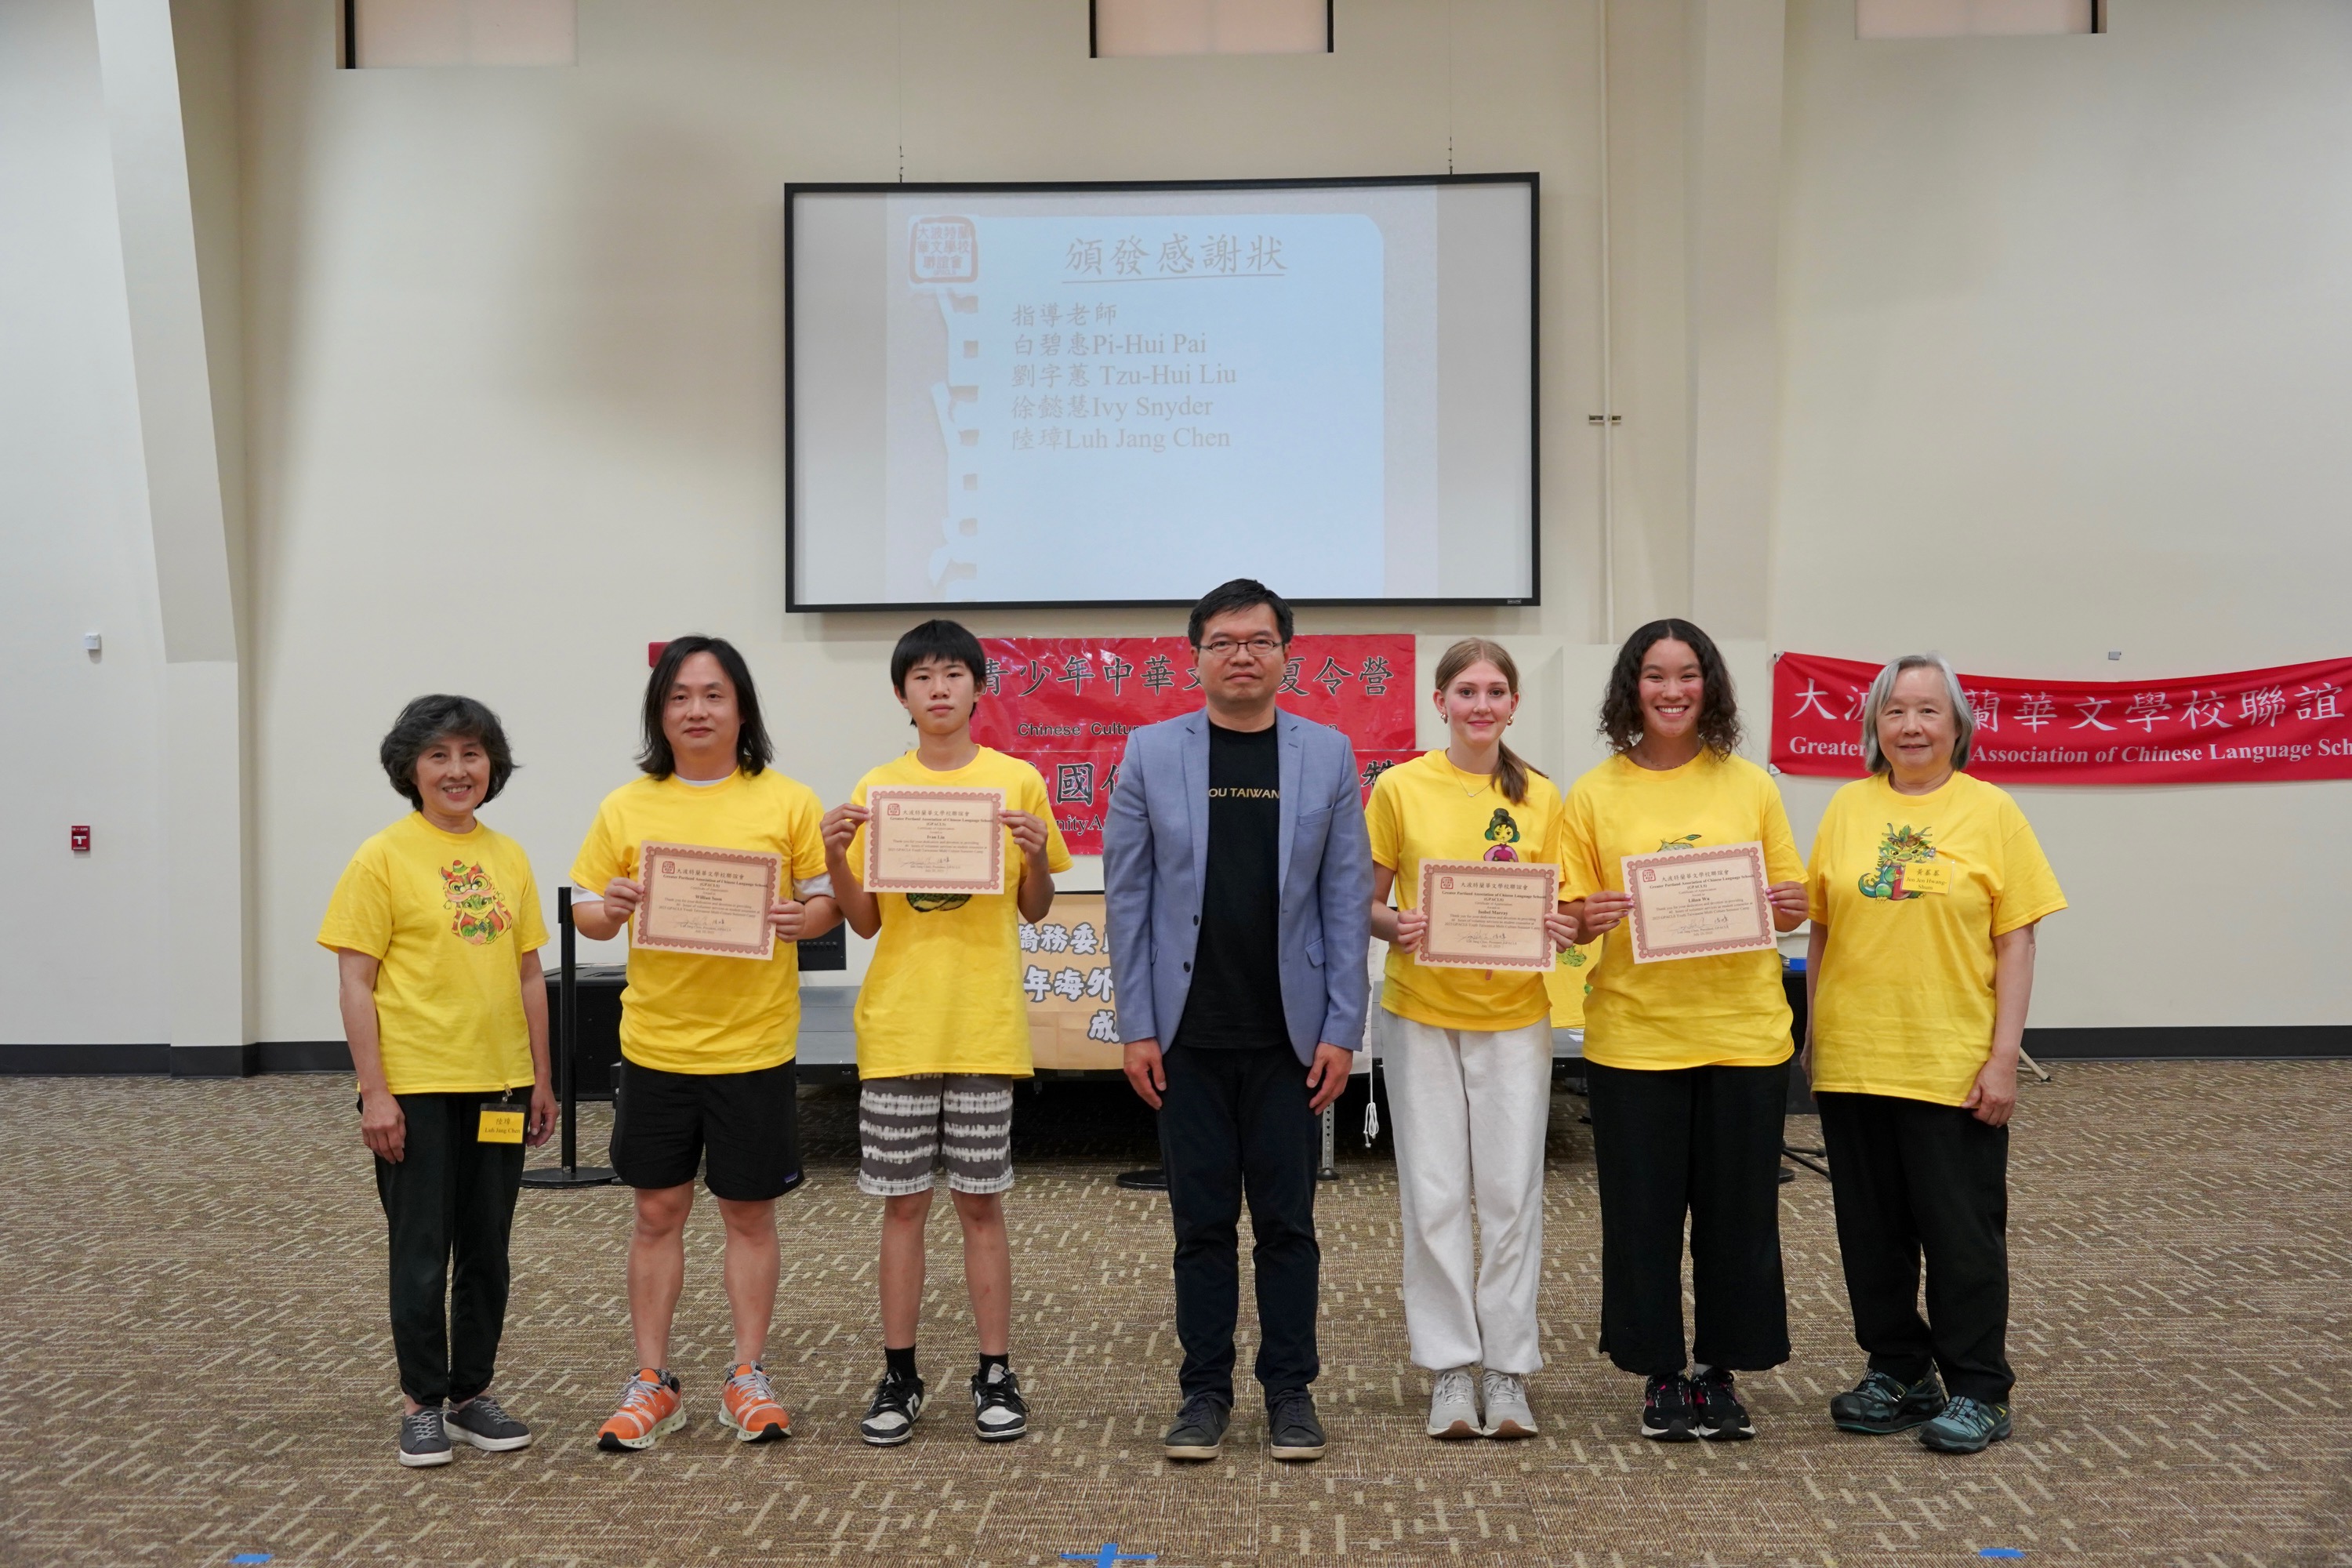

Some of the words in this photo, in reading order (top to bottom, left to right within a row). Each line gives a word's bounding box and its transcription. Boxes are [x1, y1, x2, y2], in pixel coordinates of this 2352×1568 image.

[1065, 233, 1288, 275] 頒發感謝狀
[1011, 302, 1117, 328] 指導老師
[1172, 332, 1207, 354] Pai
[1099, 363, 1192, 385] Tzu-Hui
[1199, 363, 1237, 384] Liu
[1136, 395, 1214, 421] Snyder
[1116, 428, 1167, 453] Jang
[1173, 426, 1232, 448] Chen
[1018, 722, 1082, 736] Chinese
[1789, 735, 1866, 757] Greater
[1970, 745, 2089, 763] Association
[2095, 746, 2118, 763] of
[2122, 745, 2203, 763] Chinese
[2209, 742, 2313, 763] Language
[1230, 787, 1280, 799] TAIWAN
